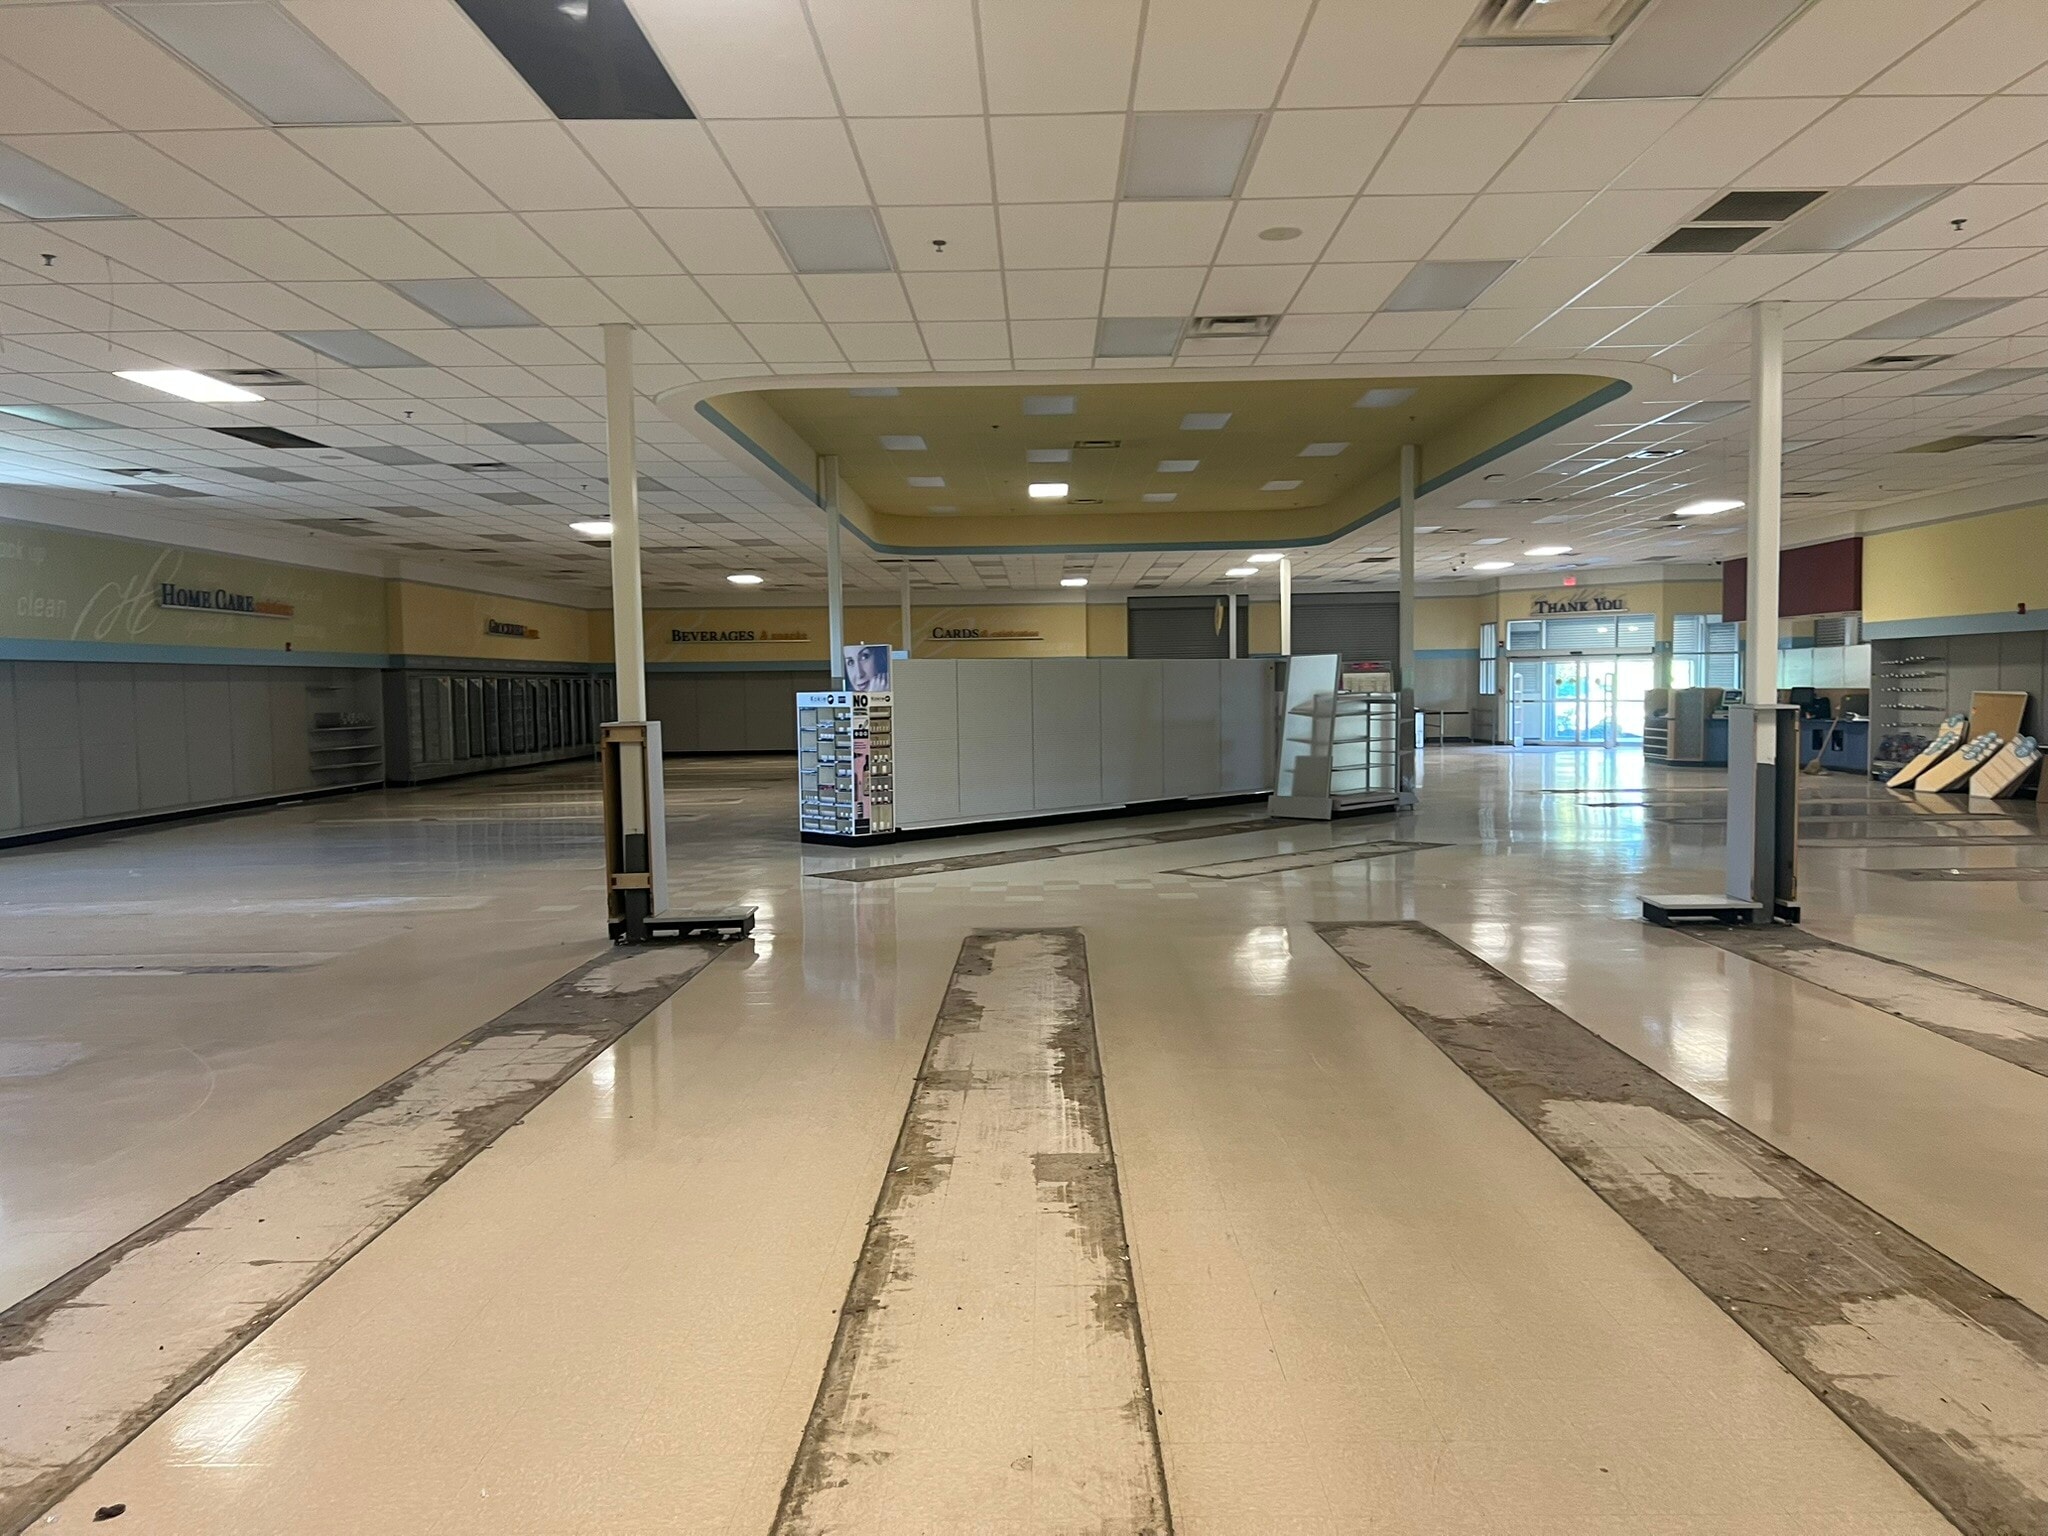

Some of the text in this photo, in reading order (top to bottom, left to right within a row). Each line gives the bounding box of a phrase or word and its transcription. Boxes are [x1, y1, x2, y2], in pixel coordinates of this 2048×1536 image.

[161, 582, 211, 608] HOME
[215, 589, 255, 612] CARE
[1535, 597, 1623, 614] THANK YOU
[671, 629, 755, 642] BEVERAGES
[932, 626, 980, 639] CARDS
[853, 695, 868, 708] NO
